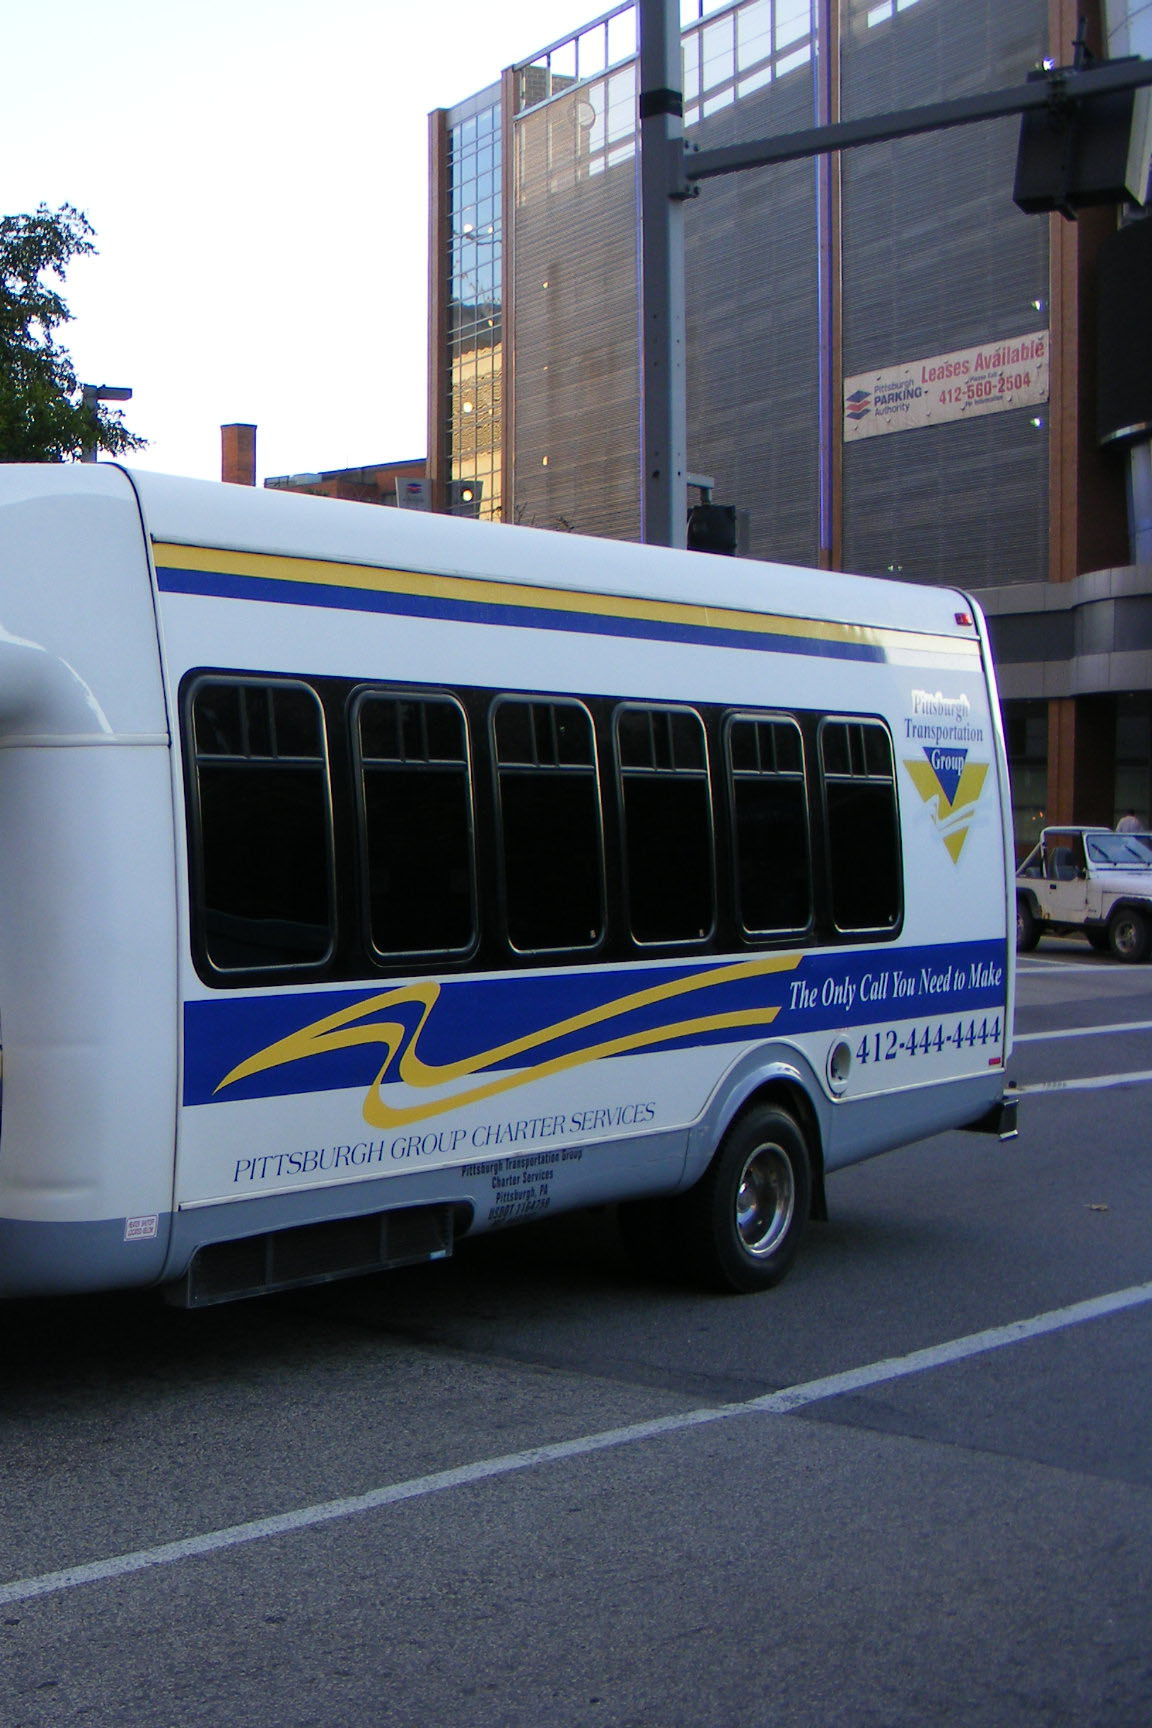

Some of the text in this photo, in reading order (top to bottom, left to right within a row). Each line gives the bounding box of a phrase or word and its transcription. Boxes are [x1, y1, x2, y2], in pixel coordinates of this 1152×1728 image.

[921, 341, 1045, 384] Leases Available
[874, 378, 914, 394] Pittsburgh
[874, 387, 923, 406] PARKING
[939, 371, 1031, 404] 412-560-2504
[875, 402, 911, 417] Authority
[912, 690, 970, 720] Pittsburgh
[904, 718, 983, 745] Transportation
[931, 749, 964, 776] Group
[789, 961, 1002, 1011] The Only Call You Need to Make
[855, 1015, 1001, 1064] 412-444-4444
[232, 1101, 656, 1182] PITTSBURGH GROUP CHARTER SERVICES
[461, 1149, 583, 1177] Pittsburgh Transportation Group
[491, 1169, 554, 1189] Charter Services
[540, 1184, 548, 1196] PA
[488, 1204, 514, 1220] USDOT
